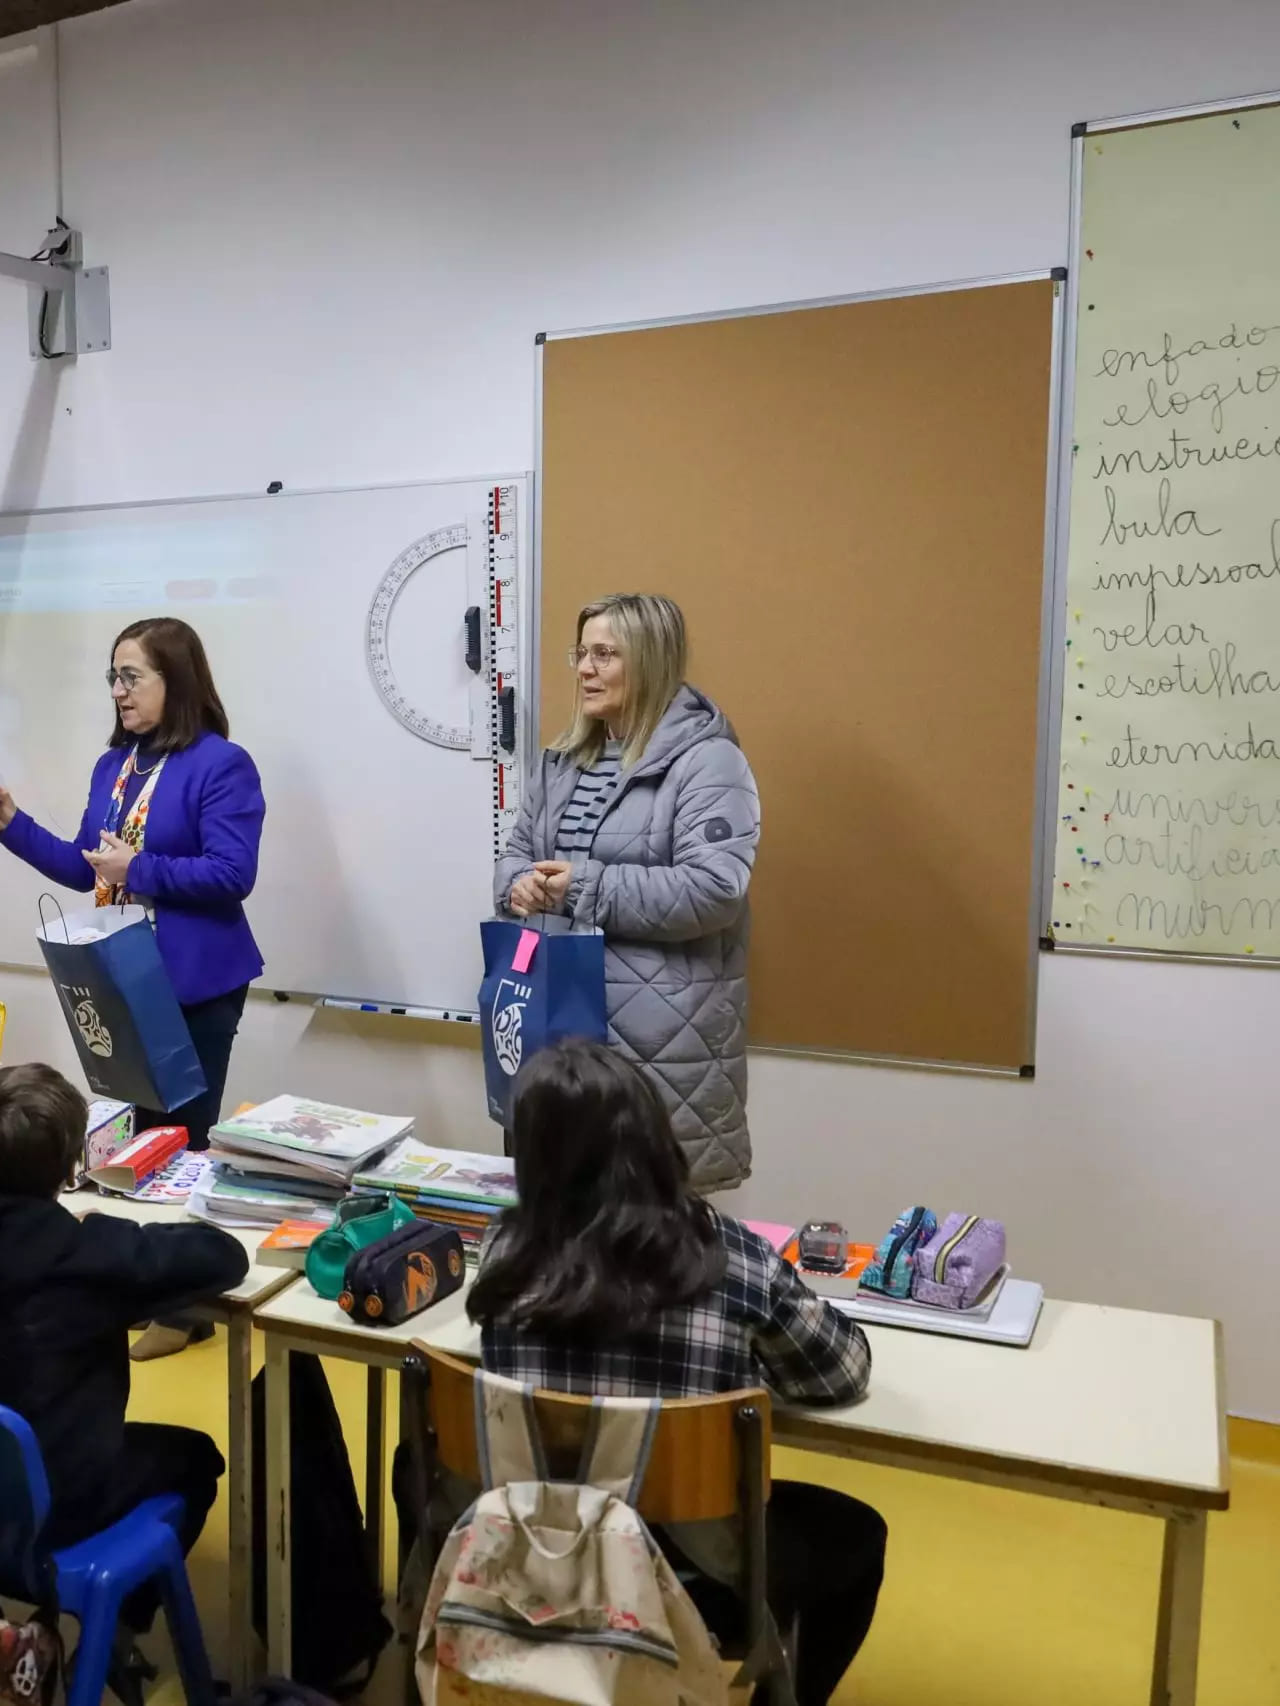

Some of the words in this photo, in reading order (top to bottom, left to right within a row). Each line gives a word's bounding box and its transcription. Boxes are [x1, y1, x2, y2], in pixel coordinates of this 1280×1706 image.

[1093, 324, 1280, 386] enfado
[1103, 357, 1280, 434] elogio
[1100, 477, 1222, 545] bula
[1093, 591, 1209, 651] velar
[1096, 642, 1280, 700] escotilha
[1105, 721, 1280, 768] eternida
[1108, 788, 1280, 828] univer
